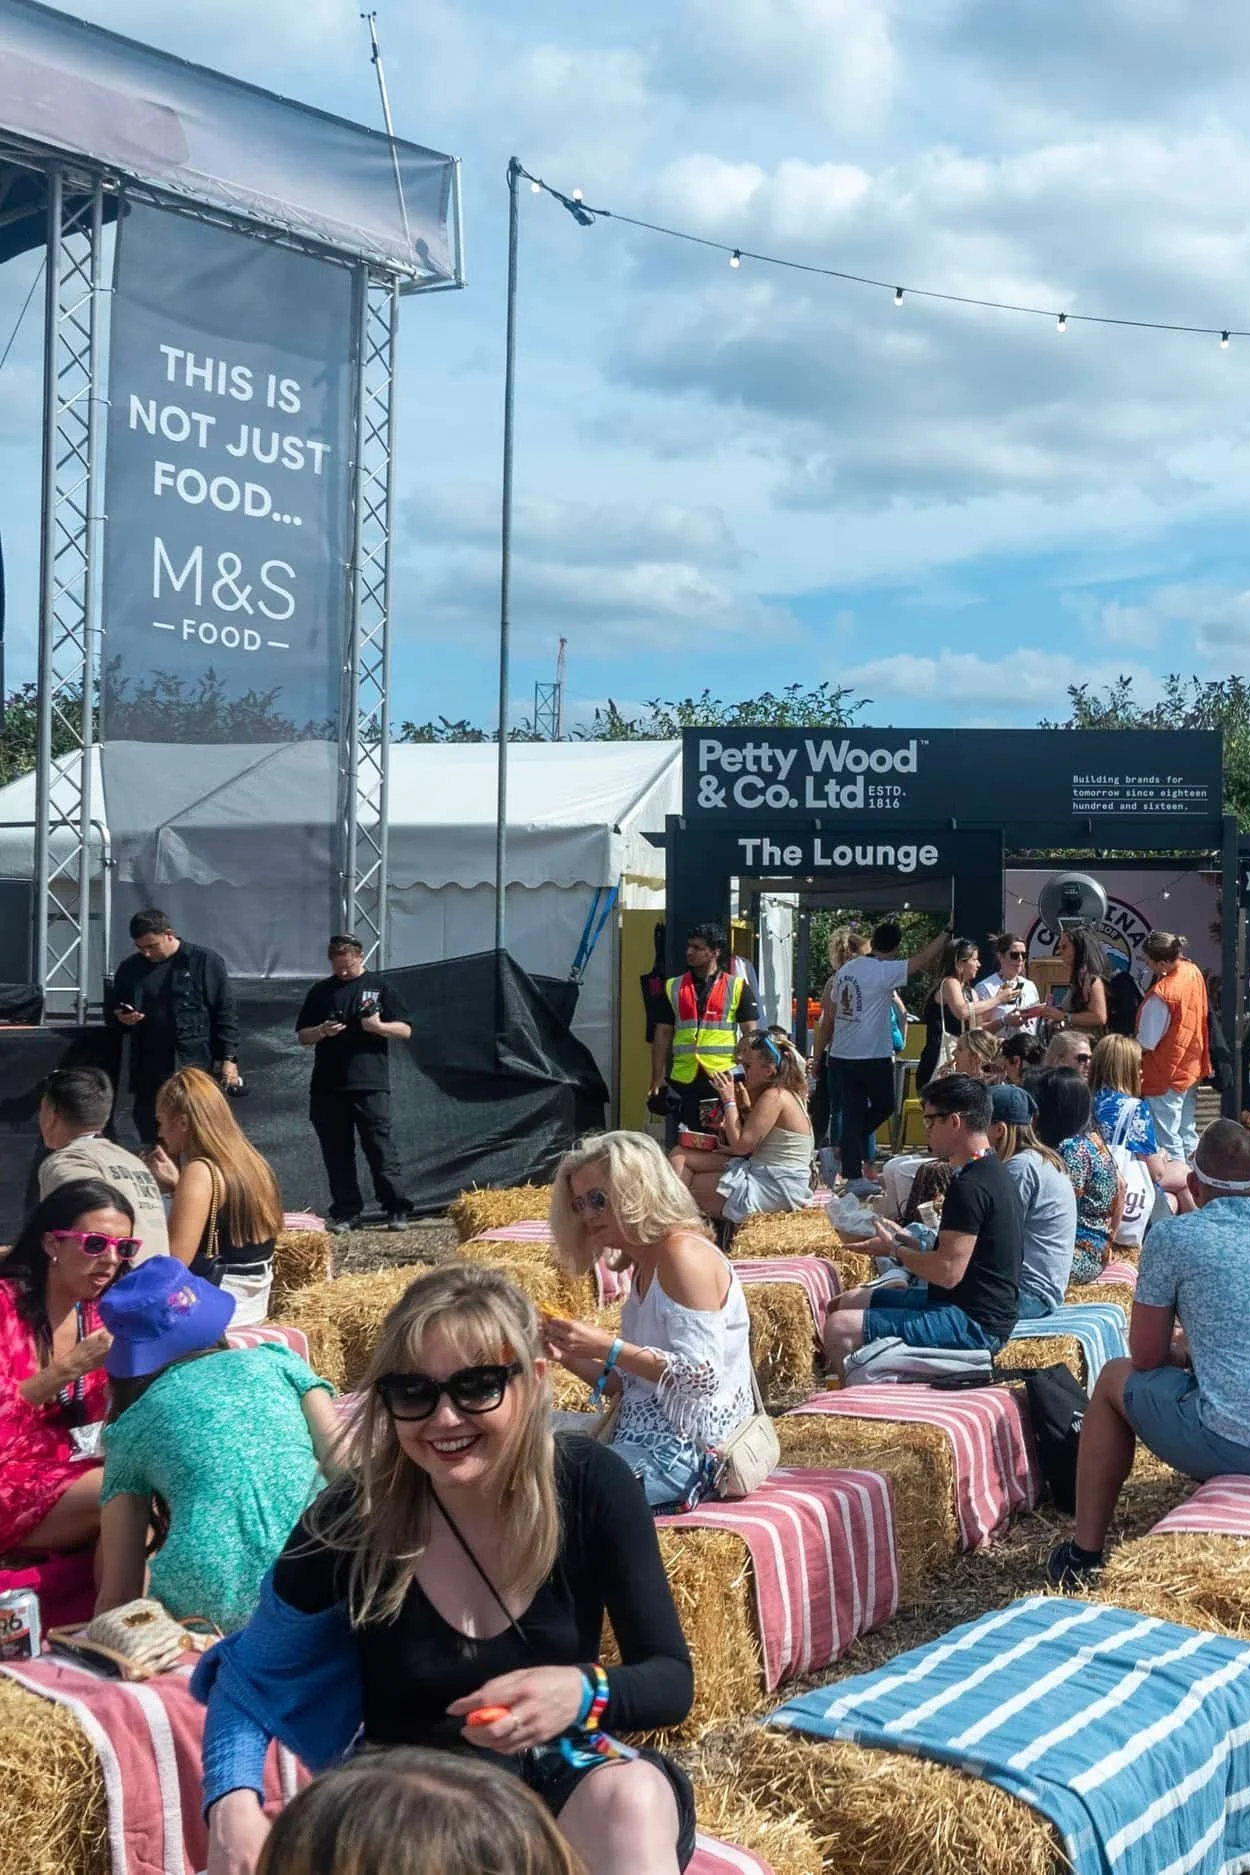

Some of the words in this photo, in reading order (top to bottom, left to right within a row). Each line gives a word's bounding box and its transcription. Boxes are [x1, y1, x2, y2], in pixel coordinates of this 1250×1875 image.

[159, 344, 254, 401] THIS
[266, 374, 301, 414] IS
[129, 394, 216, 448] NOT
[226, 424, 332, 475] JUST
[153, 461, 302, 526] FOOD...
[152, 536, 296, 621] M&S
[182, 619, 262, 650] FOOD
[699, 739, 798, 780] Petty
[804, 739, 918, 774] Wood
[697, 775, 728, 808] &
[733, 775, 798, 809] Co.
[805, 775, 865, 808] Ltd
[868, 785, 907, 796] ESTD.
[1073, 775, 1120, 785] Building
[1125, 775, 1160, 784] brands
[1167, 775, 1184, 784] for
[1073, 789, 1120, 797] tomorrow
[1126, 789, 1154, 797] since
[1160, 788, 1207, 798] eighteen
[868, 798, 900, 809] 1816
[1073, 802, 1114, 810] hundred
[1120, 802, 1137, 810] and
[1143, 802, 1189, 810] sixteen.
[738, 838, 802, 866] The
[814, 838, 939, 873] Lounge
